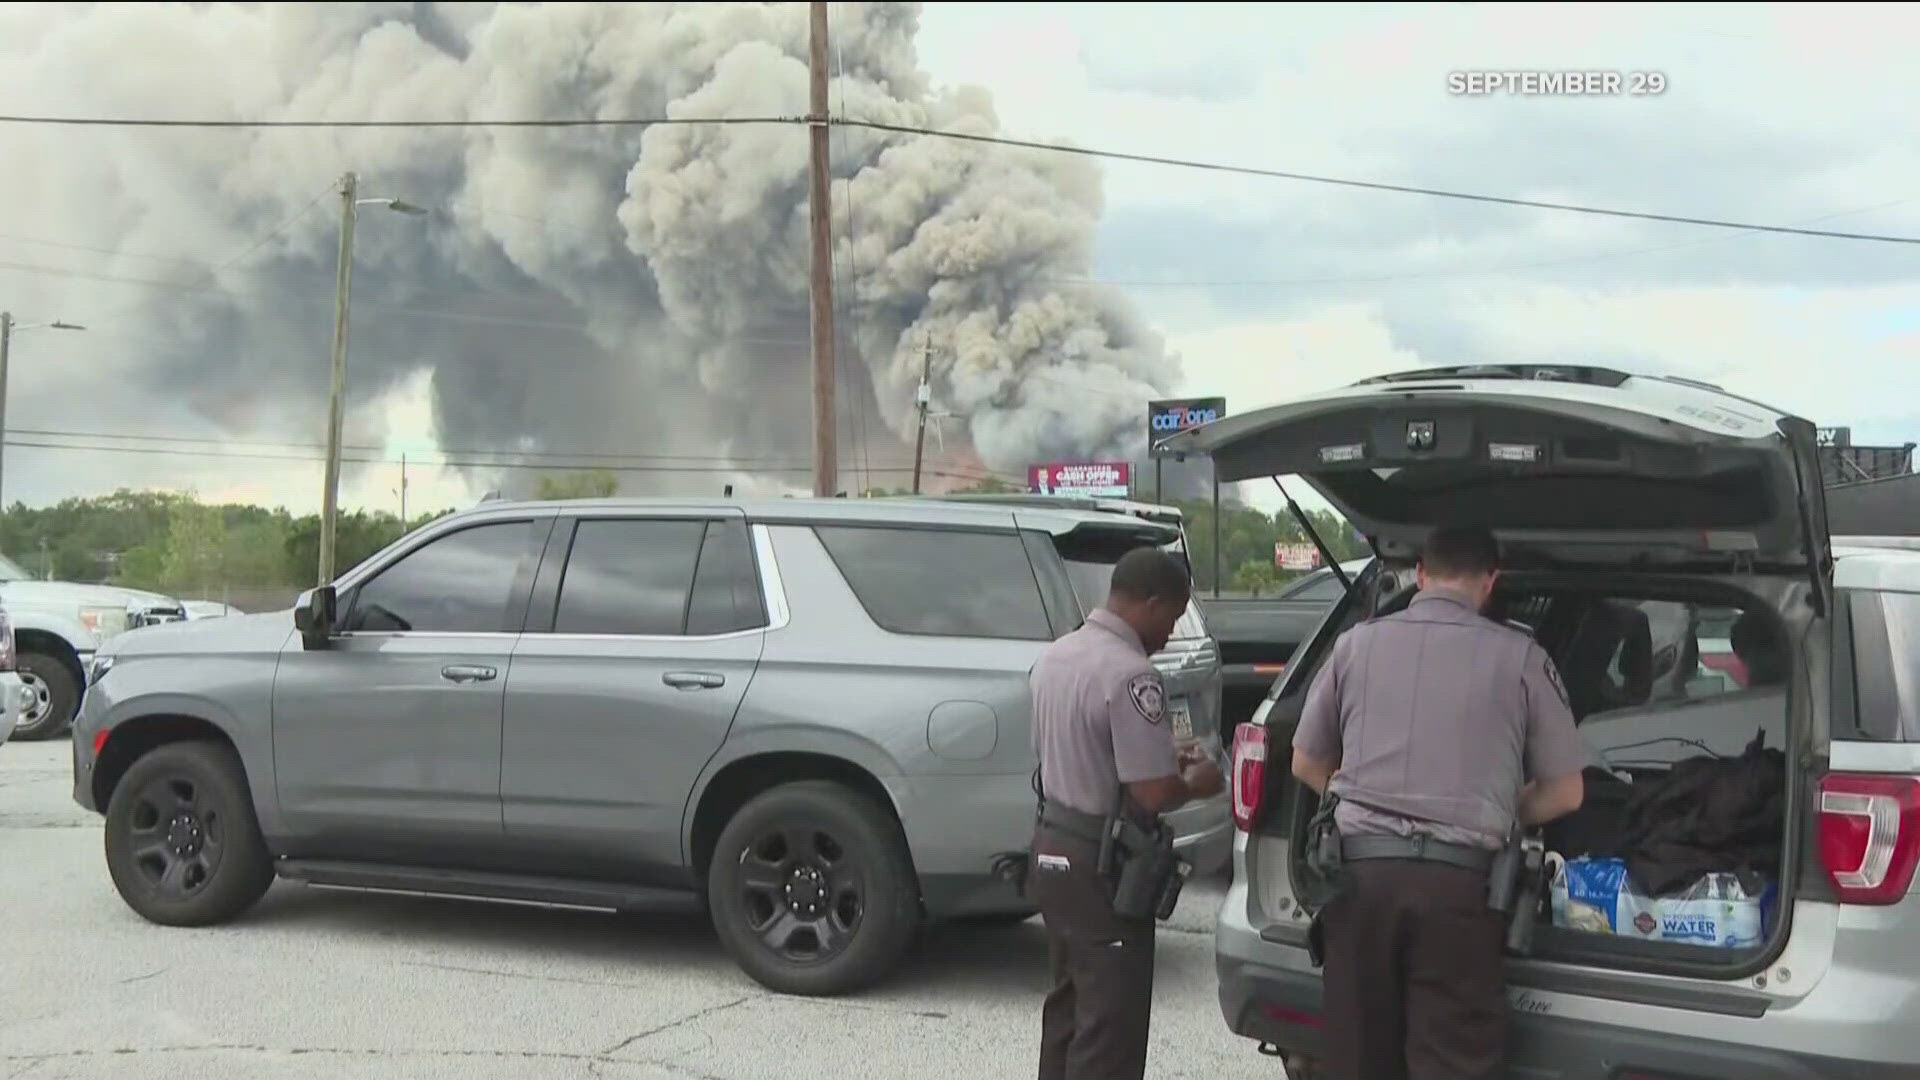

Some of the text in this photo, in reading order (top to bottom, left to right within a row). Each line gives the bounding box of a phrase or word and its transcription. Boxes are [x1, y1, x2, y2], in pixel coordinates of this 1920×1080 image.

[1056, 470, 1120, 481] CASH OFFER
[1663, 920, 1715, 934] WATER
